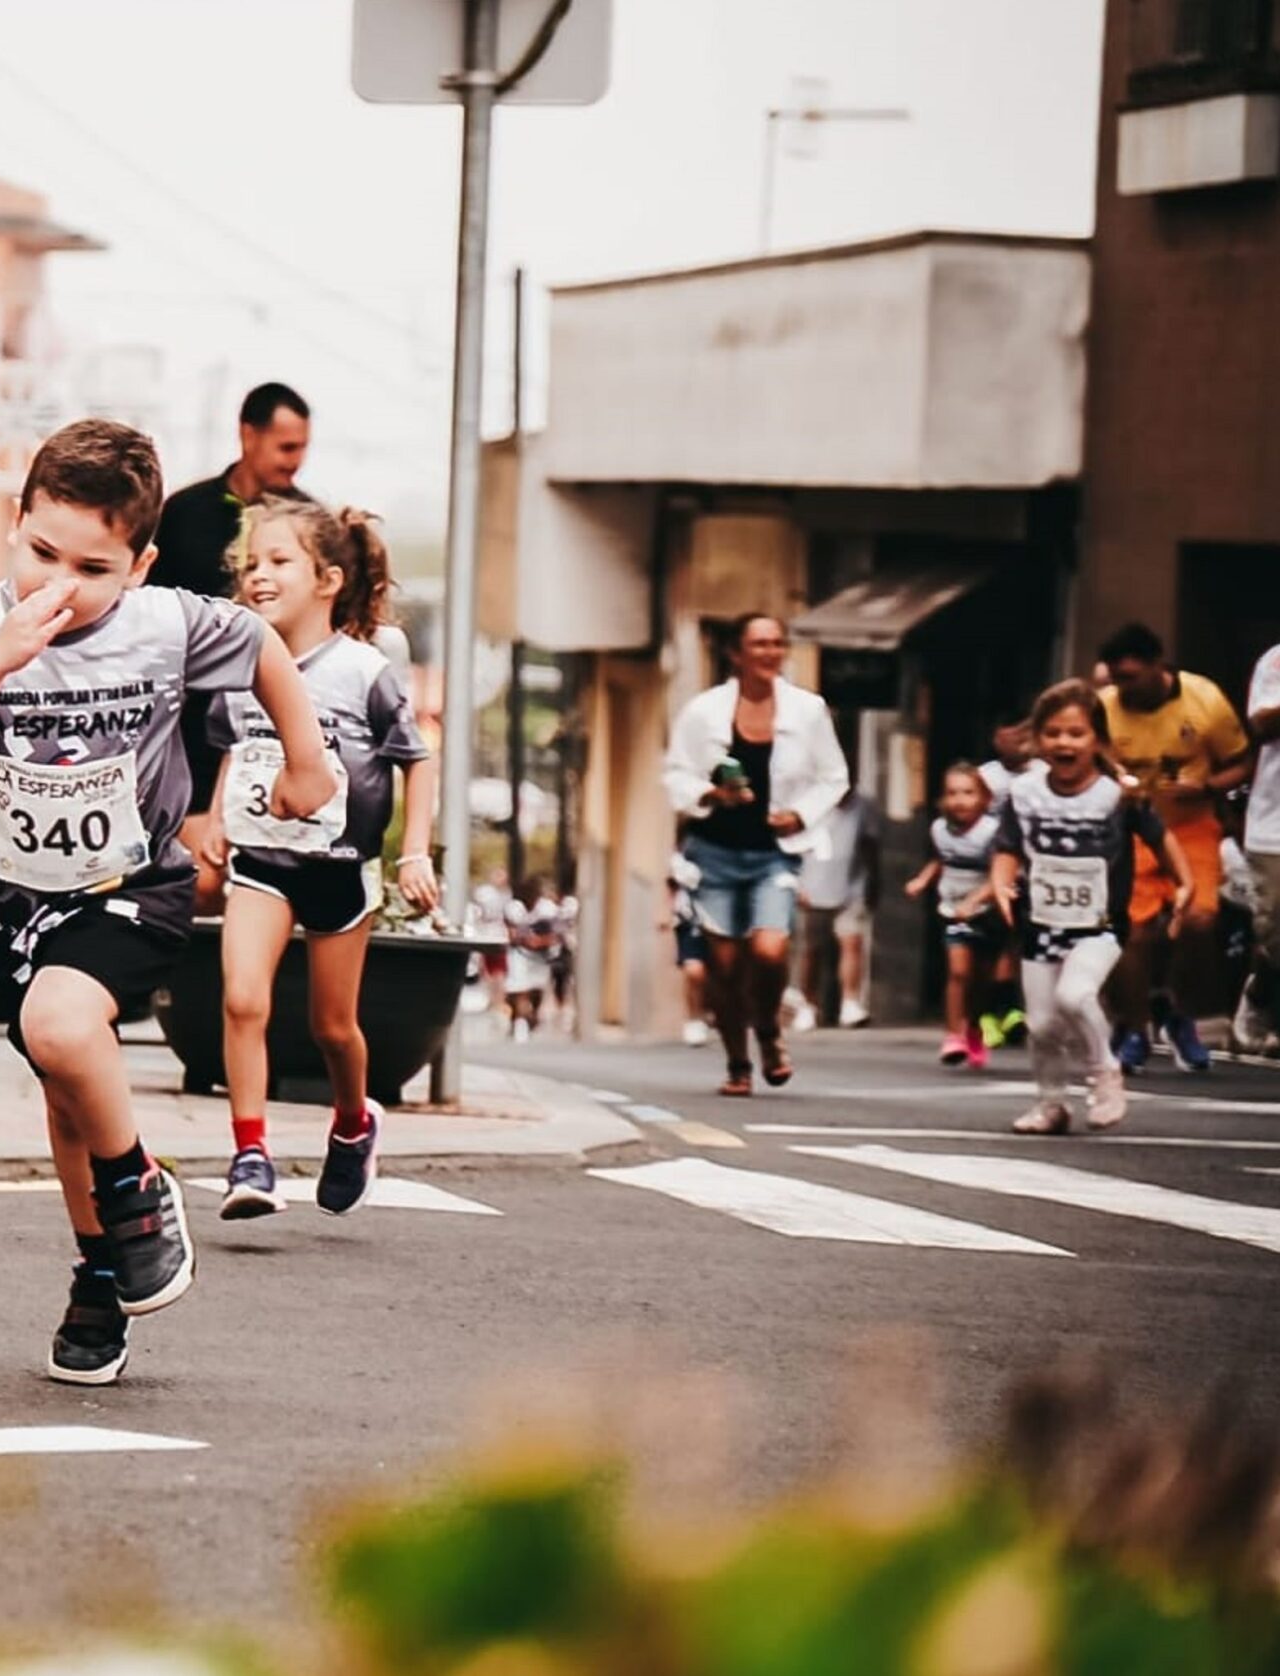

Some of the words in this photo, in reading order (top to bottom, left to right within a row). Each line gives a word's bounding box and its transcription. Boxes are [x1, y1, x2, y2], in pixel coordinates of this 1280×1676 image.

[13, 702, 155, 740] ESPERANZA
[18, 767, 125, 798] ESPERANZA
[10, 808, 111, 857] 340
[1037, 879, 1092, 908] 338
